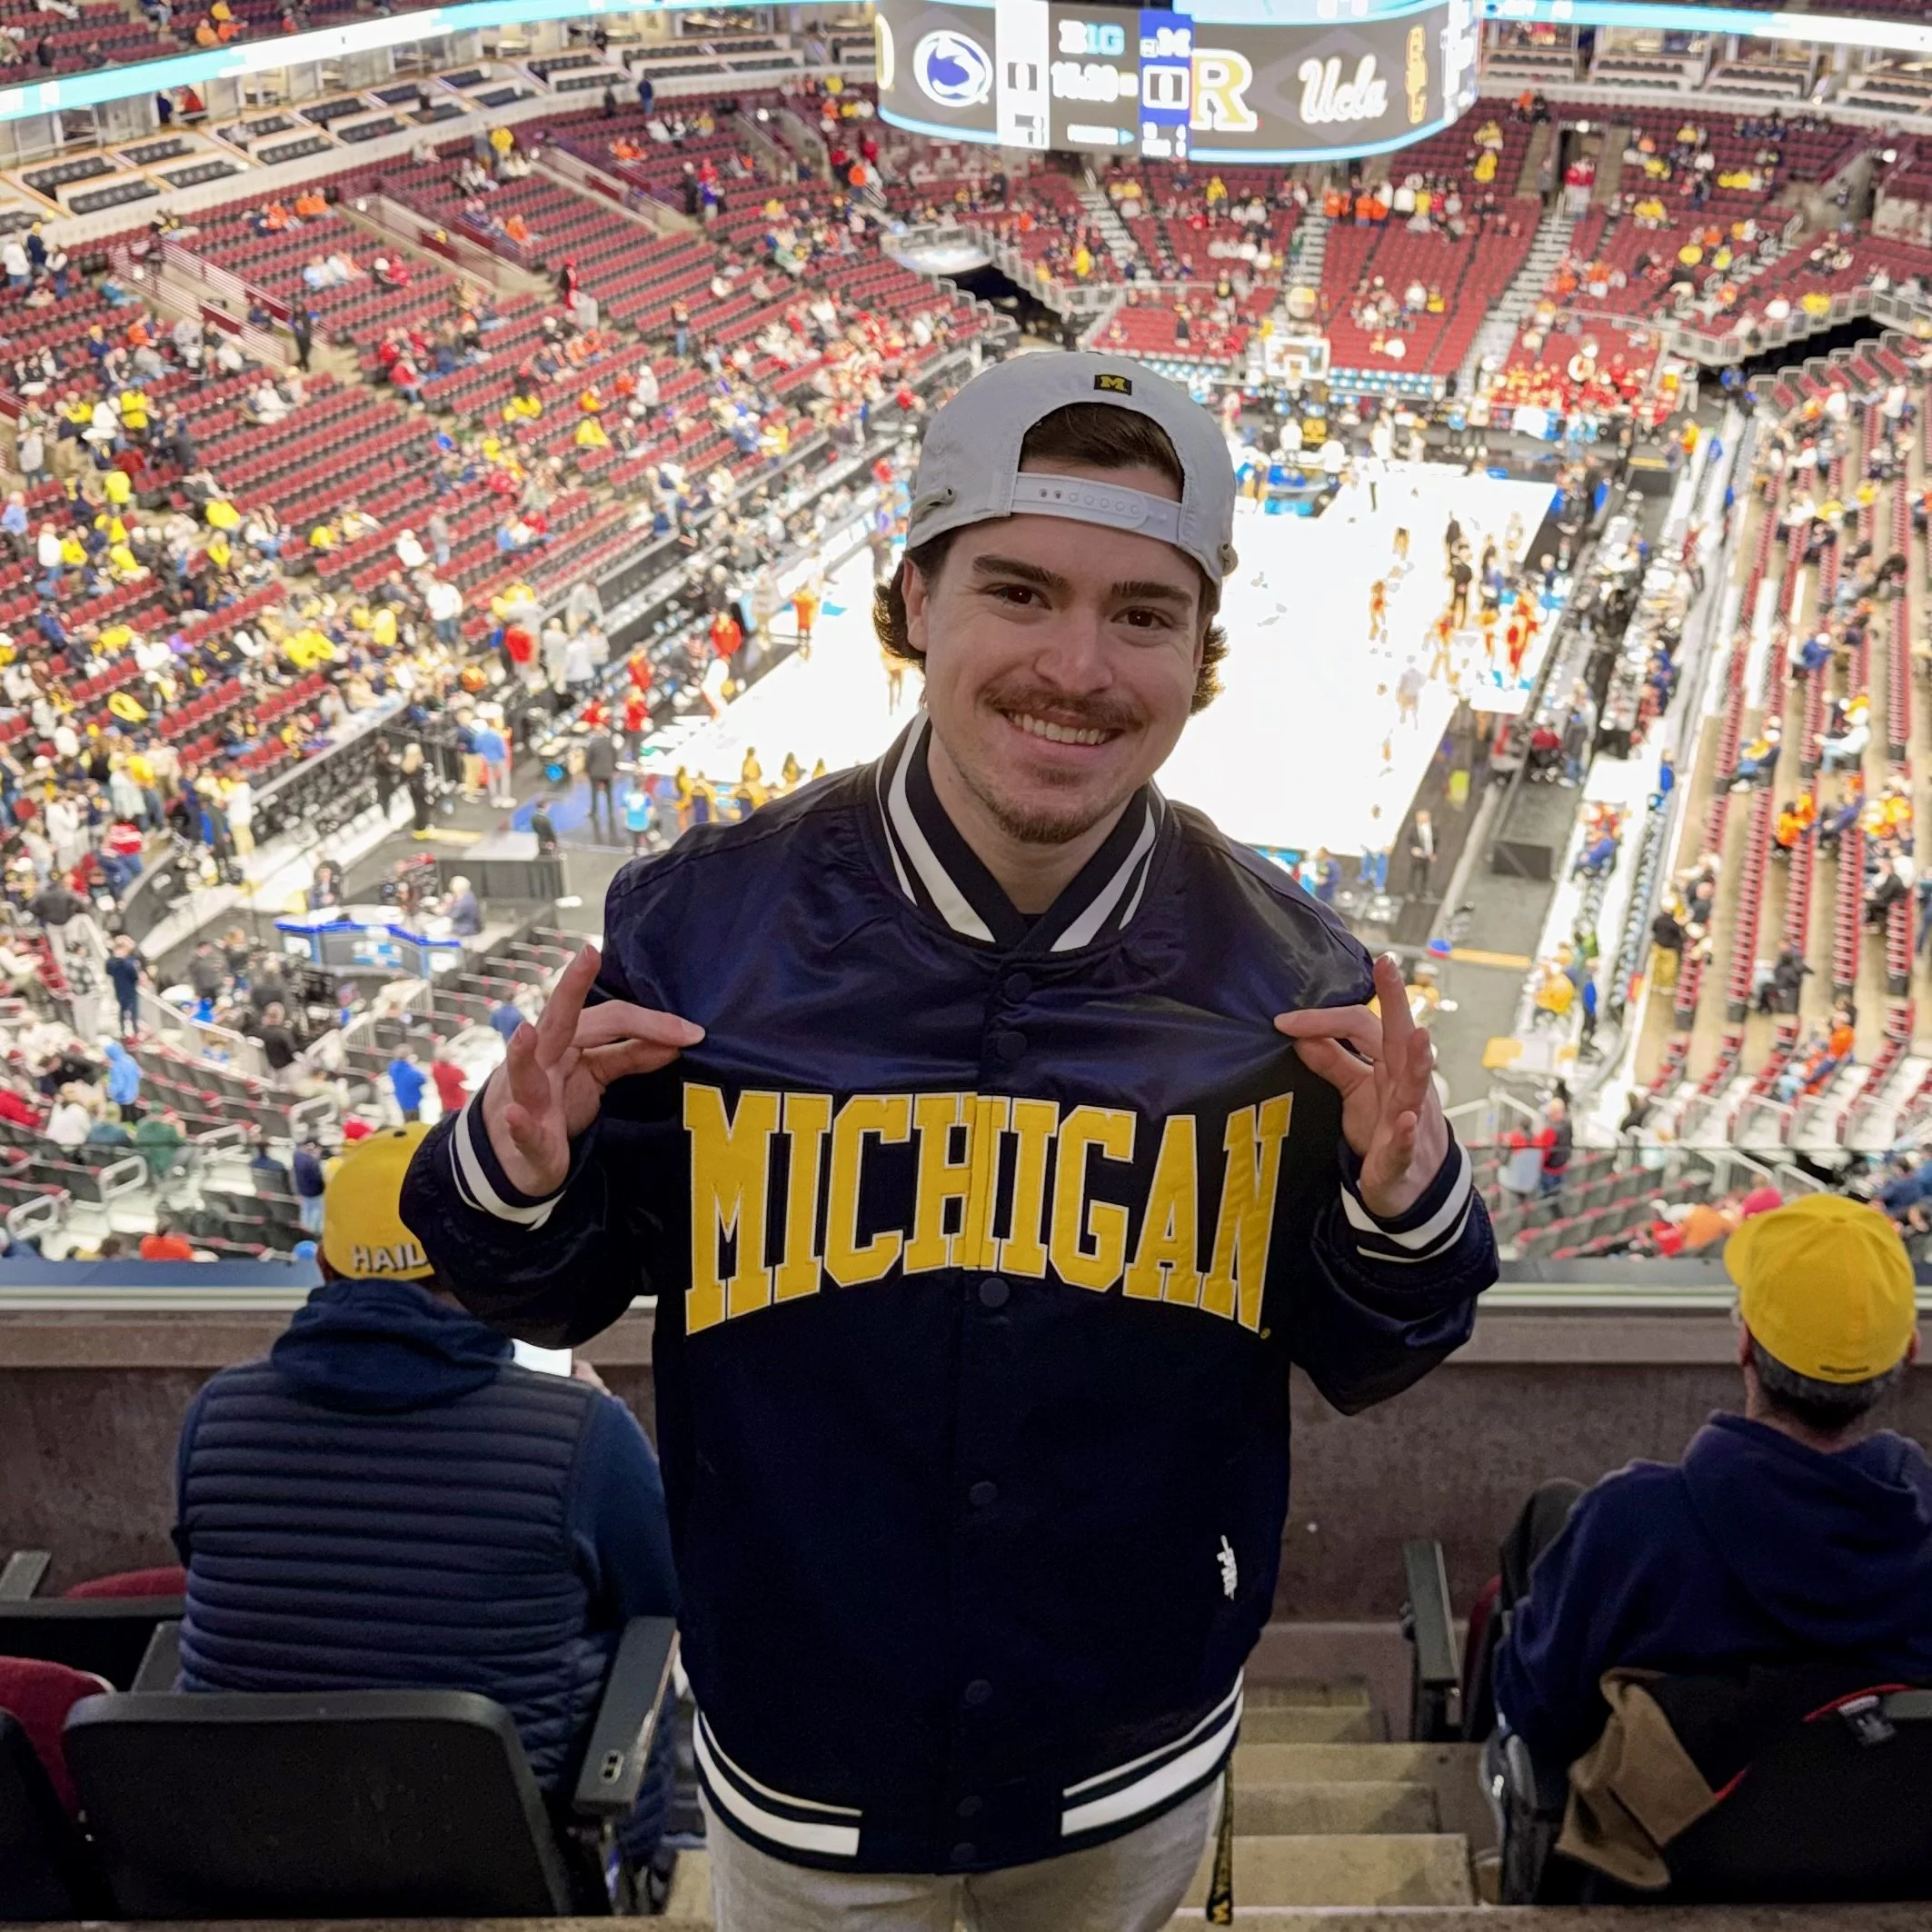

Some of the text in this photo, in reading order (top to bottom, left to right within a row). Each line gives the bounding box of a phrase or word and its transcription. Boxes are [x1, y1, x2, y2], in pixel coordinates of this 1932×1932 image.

[1188, 48, 1258, 132] R
[1100, 375, 1125, 391] M
[683, 1081, 1294, 1334] MICHIGAN
[351, 1242, 429, 1271] HAIL
